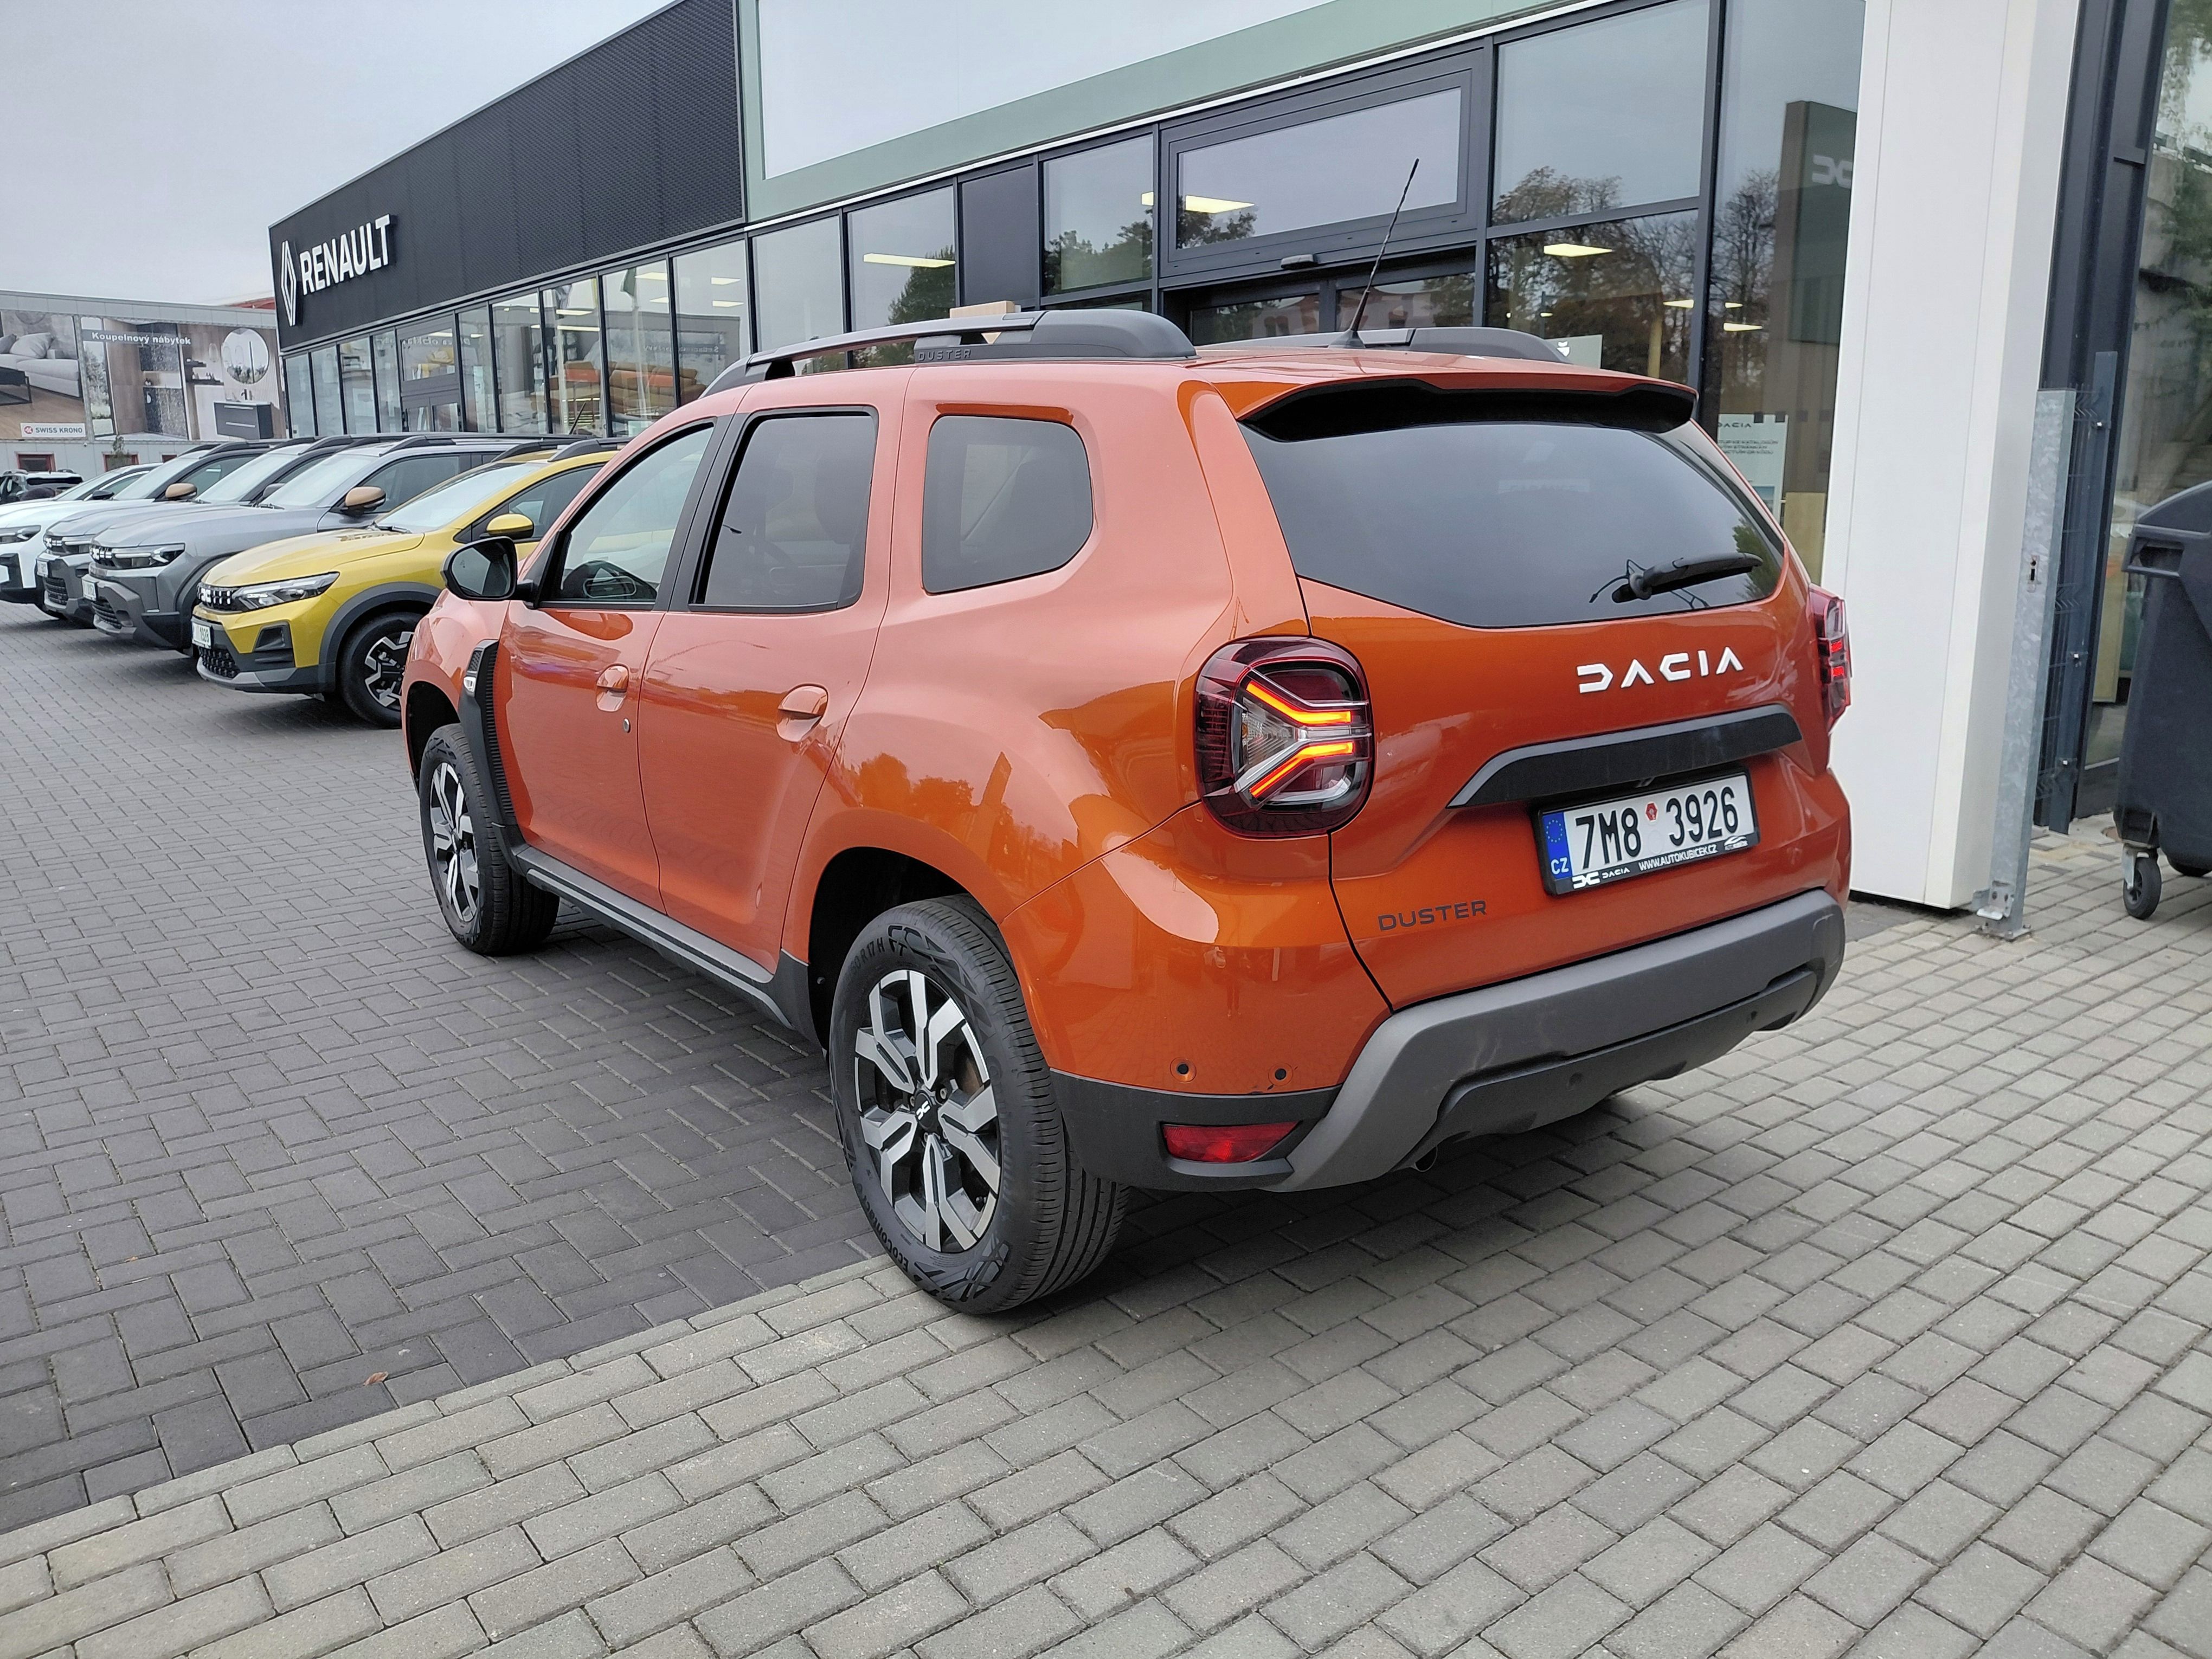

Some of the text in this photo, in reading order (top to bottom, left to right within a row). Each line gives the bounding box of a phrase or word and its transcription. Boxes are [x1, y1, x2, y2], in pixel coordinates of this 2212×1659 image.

[299, 214, 390, 295] RENAULT
[92, 332, 191, 345] Koupelnový nábytek
[918, 349, 971, 362] DUSTER
[1577, 647, 1744, 693] DACIA
[1575, 786, 1739, 870] 7M8 3926
[1551, 857, 1569, 875] CZ
[1638, 844, 1718, 871] WWW.AUTOKUBICEK.CZ
[1602, 867, 1630, 879] DACIA
[1378, 900, 1487, 931] DUSTER
